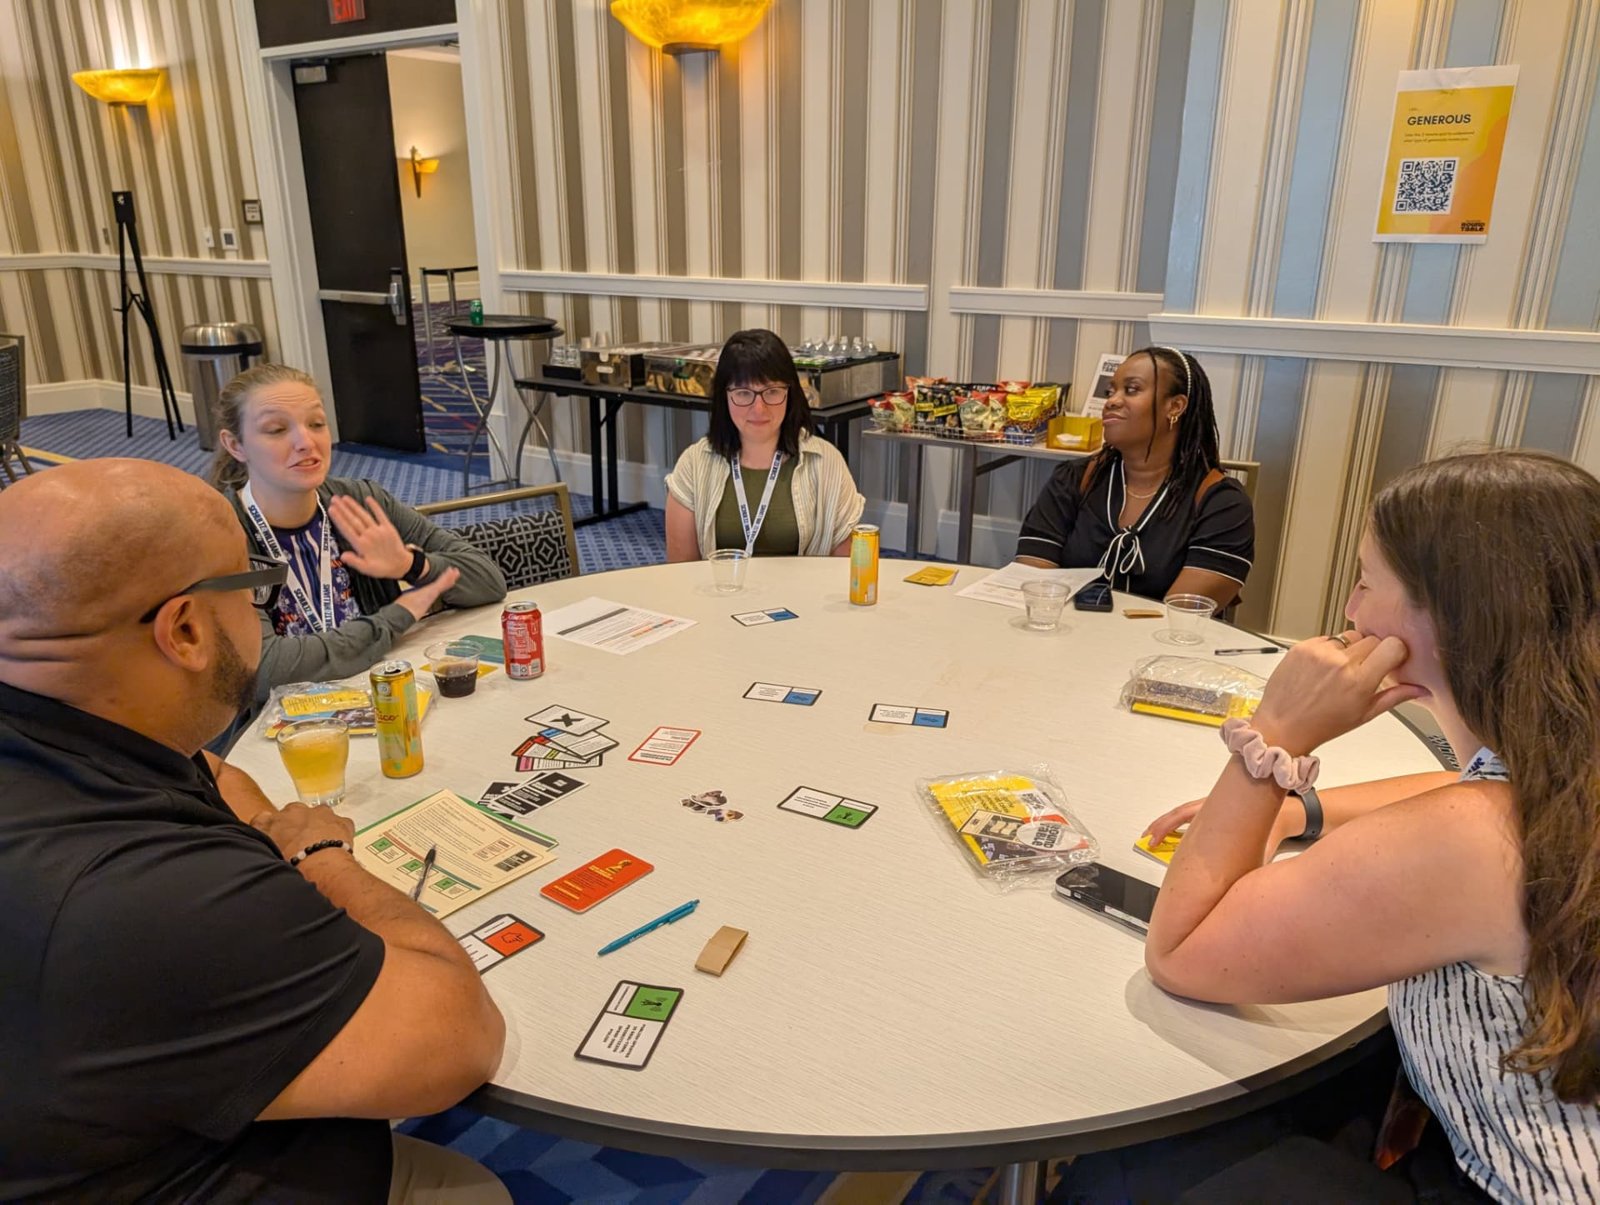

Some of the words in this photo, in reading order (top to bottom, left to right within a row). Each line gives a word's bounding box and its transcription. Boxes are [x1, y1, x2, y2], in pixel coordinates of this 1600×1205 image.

[1407, 114, 1472, 126] GENEROUS
[248, 505, 267, 530] SCHULTZ
[263, 529, 281, 558] WILLIAMS
[294, 588, 312, 613] SCHULTZ
[308, 612, 322, 632] WILLIA
